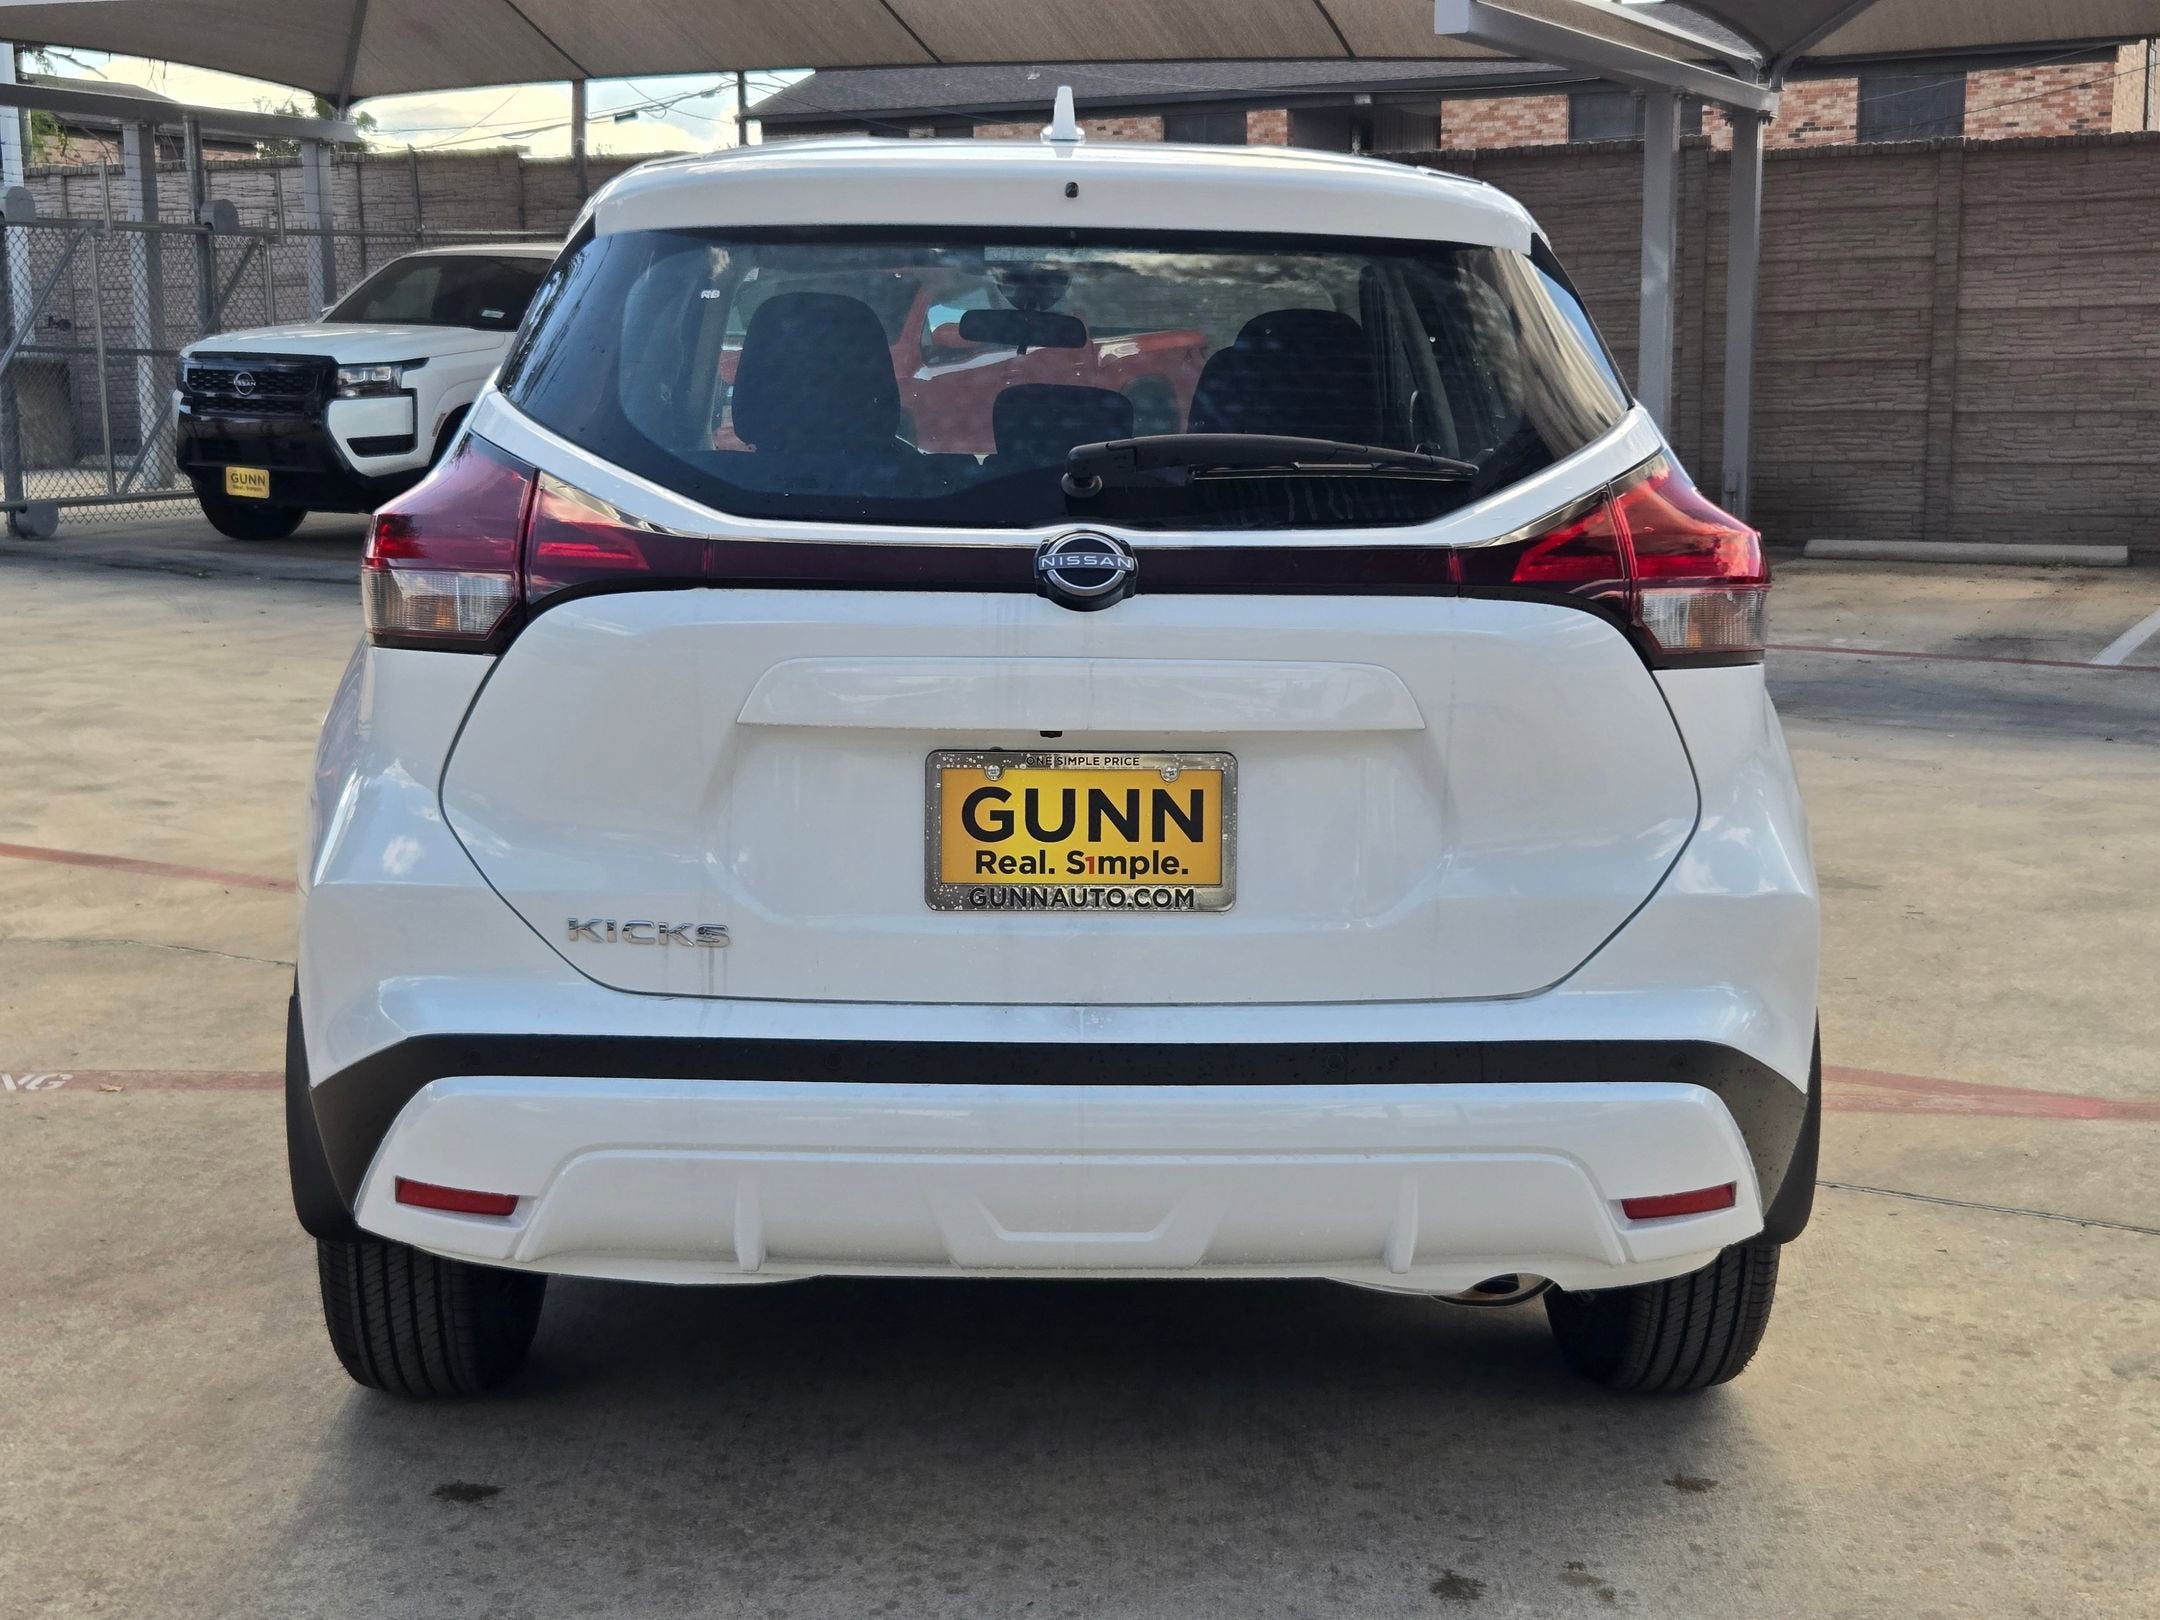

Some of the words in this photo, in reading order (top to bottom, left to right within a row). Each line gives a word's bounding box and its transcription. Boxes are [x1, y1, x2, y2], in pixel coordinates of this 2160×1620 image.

[230, 473, 266, 486] GUNN
[1041, 555, 1131, 568] NISSAN
[1026, 756, 1053, 766] ONE
[1057, 756, 1101, 766] SIMPLE
[1104, 756, 1140, 766] PRICE
[961, 786, 1204, 843] GUNN
[975, 850, 1055, 875] Real.
[969, 887, 1195, 908] GUNNAUTO.COM
[567, 917, 731, 948] KICKS
